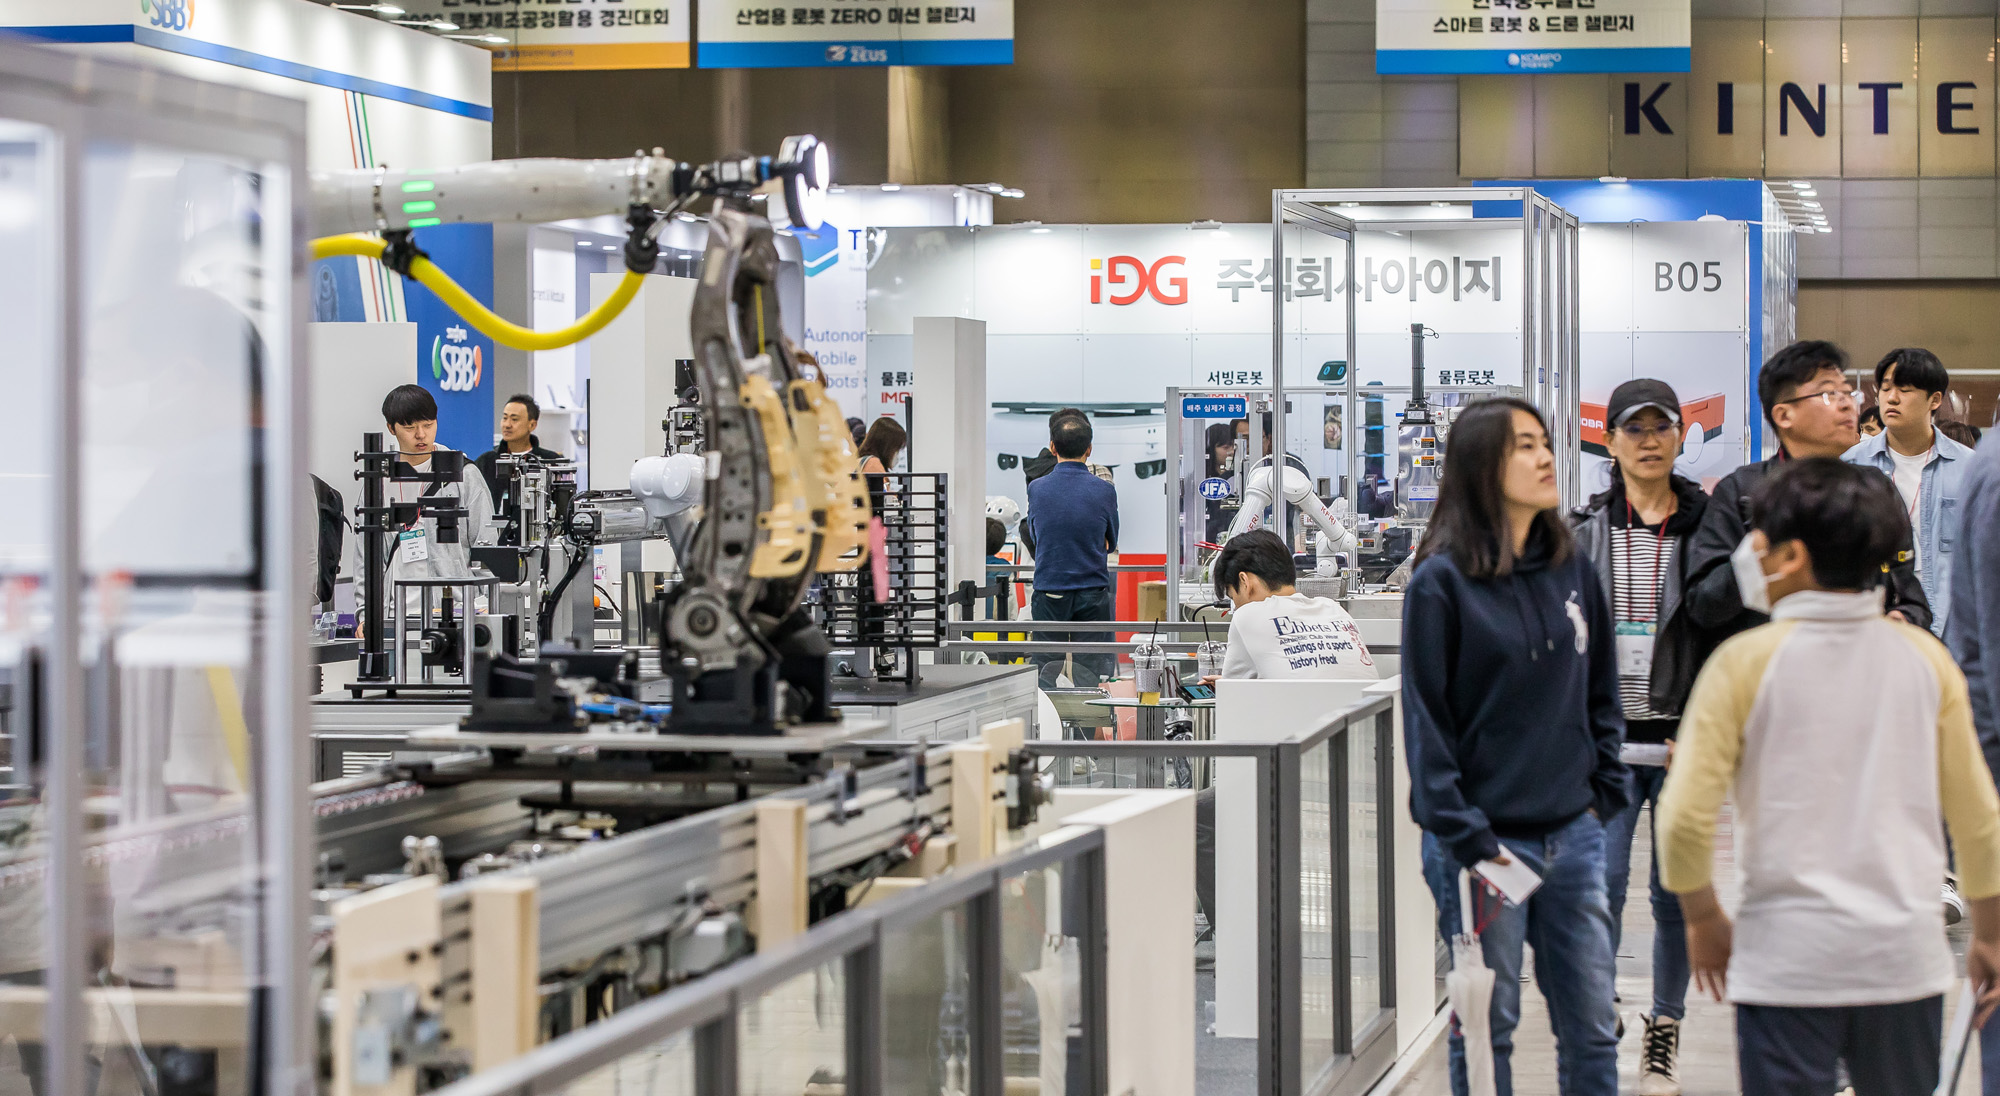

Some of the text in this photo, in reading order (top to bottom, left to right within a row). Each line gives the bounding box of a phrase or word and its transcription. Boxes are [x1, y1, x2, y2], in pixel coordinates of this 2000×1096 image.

[600, 8, 670, 27] 경진대회
[736, 6, 976, 25] 산업용 로봇 ZERO 미션 챌린지
[1433, 14, 1635, 33] 스마트 로봇 & 드론 챌린지
[1655, 261, 1722, 292] B05
[440, 344, 474, 391] SBB
[881, 372, 913, 386] 물류
[1207, 371, 1263, 386] 서빙로봇
[1438, 370, 1495, 386] 물류로봇
[1227, 404, 1243, 413] 공정
[1202, 480, 1228, 496] JFA
[1320, 505, 1337, 526] KFRI
[1269, 616, 1332, 636] Ebbets
[1283, 642, 1317, 656] musings
[1317, 640, 1326, 650] of
[1332, 640, 1353, 652] sports
[1288, 653, 1339, 670] history freak
